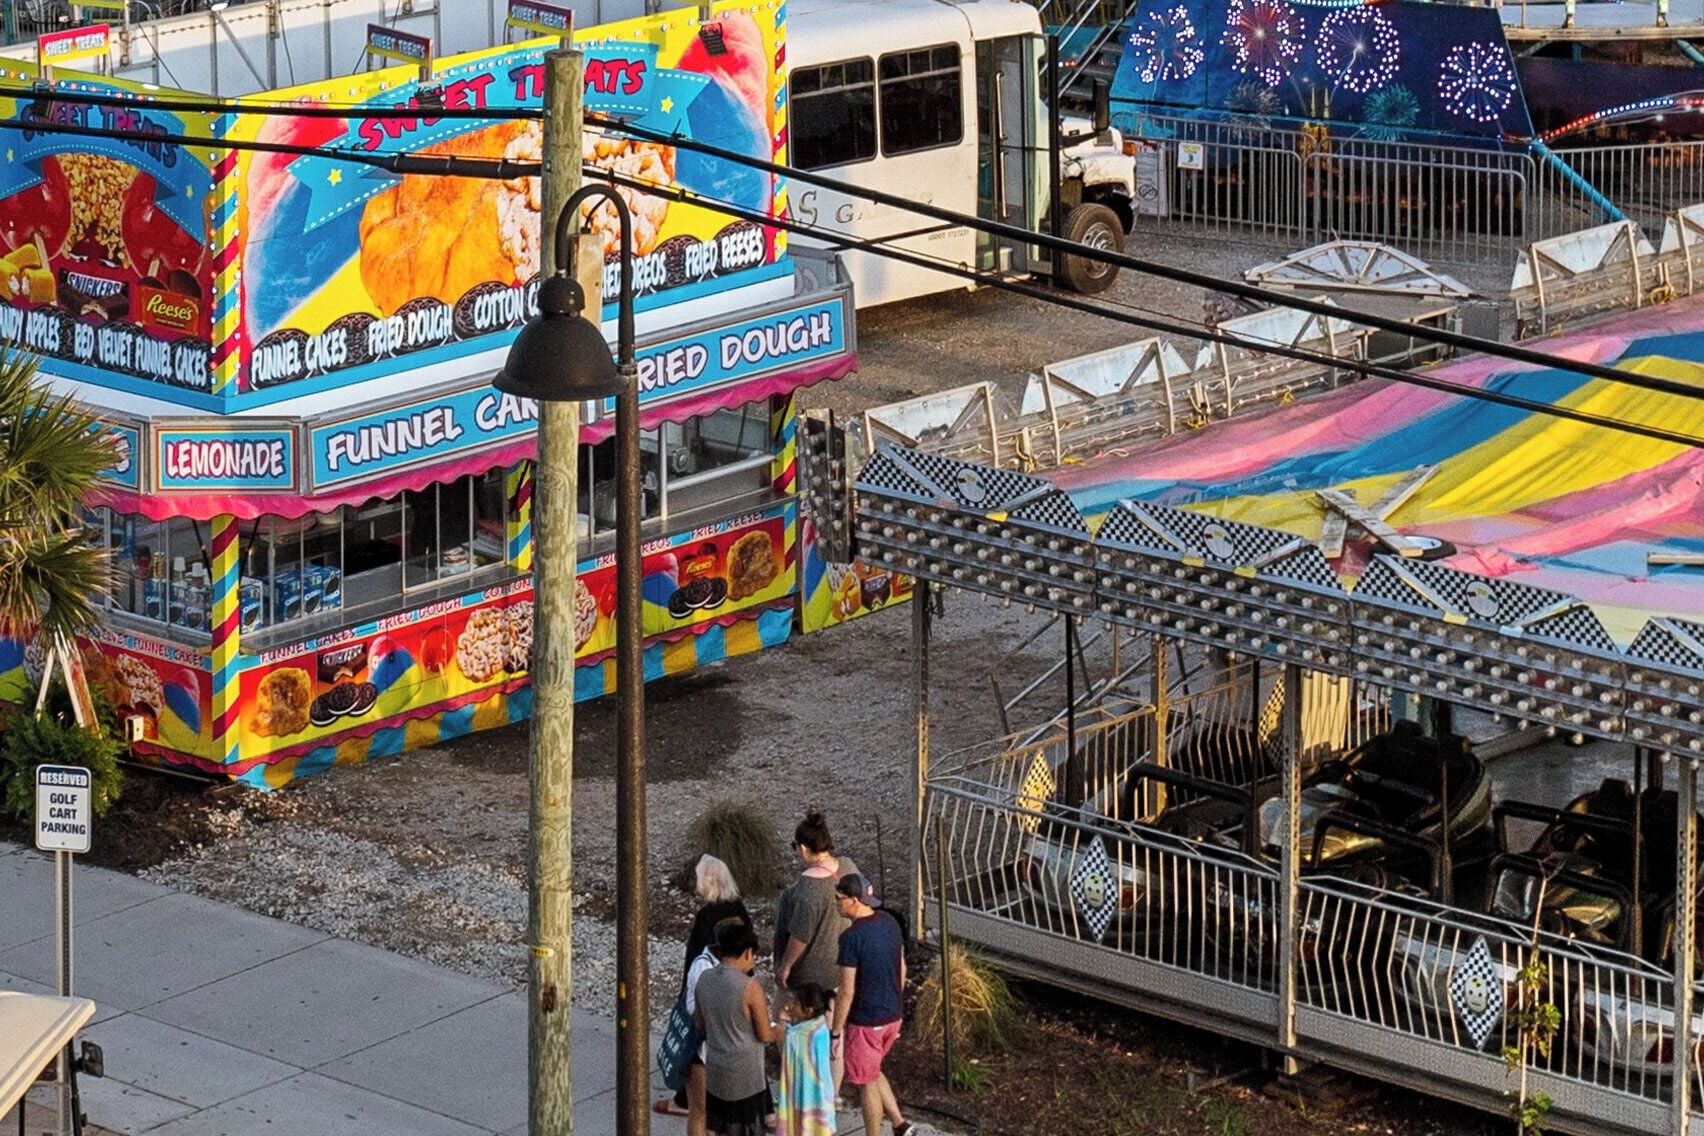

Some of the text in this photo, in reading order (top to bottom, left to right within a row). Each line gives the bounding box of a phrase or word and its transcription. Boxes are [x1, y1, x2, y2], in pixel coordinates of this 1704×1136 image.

[510, 5, 567, 29] SWEET TREATS
[45, 32, 106, 56] SWEET TREATS
[369, 32, 426, 59] SWEET TREATS
[508, 58, 647, 102] TATS
[685, 227, 765, 279] FRIED REESES
[67, 272, 122, 297] SNICKERS
[601, 262, 621, 300] IED
[146, 292, 194, 322] Reese's
[367, 314, 403, 357] FRIED
[407, 304, 454, 347] DOUGH
[473, 285, 524, 331] COTTON
[24, 314, 60, 352] APPLES
[73, 323, 209, 385] RED VELVET FUNNEL CAKES
[250, 327, 347, 384] FUNNEL CAKES
[636, 310, 833, 393] RIED DOUGH
[165, 438, 286, 480] LEMONADE
[327, 405, 465, 472] FUNNEL
[475, 391, 540, 433] CAK
[689, 510, 766, 541] FRIED REESES
[596, 535, 673, 568] FRI REOS
[260, 577, 532, 663] FUNNEL CAKES FRIED DOUGH COTTON
[97, 629, 205, 667] ELVET FUNNEL CAKES
[40, 771, 88, 787] RESERVED
[49, 792, 78, 805] GOLF
[49, 807, 78, 820] CART
[41, 821, 86, 835] PARKING
